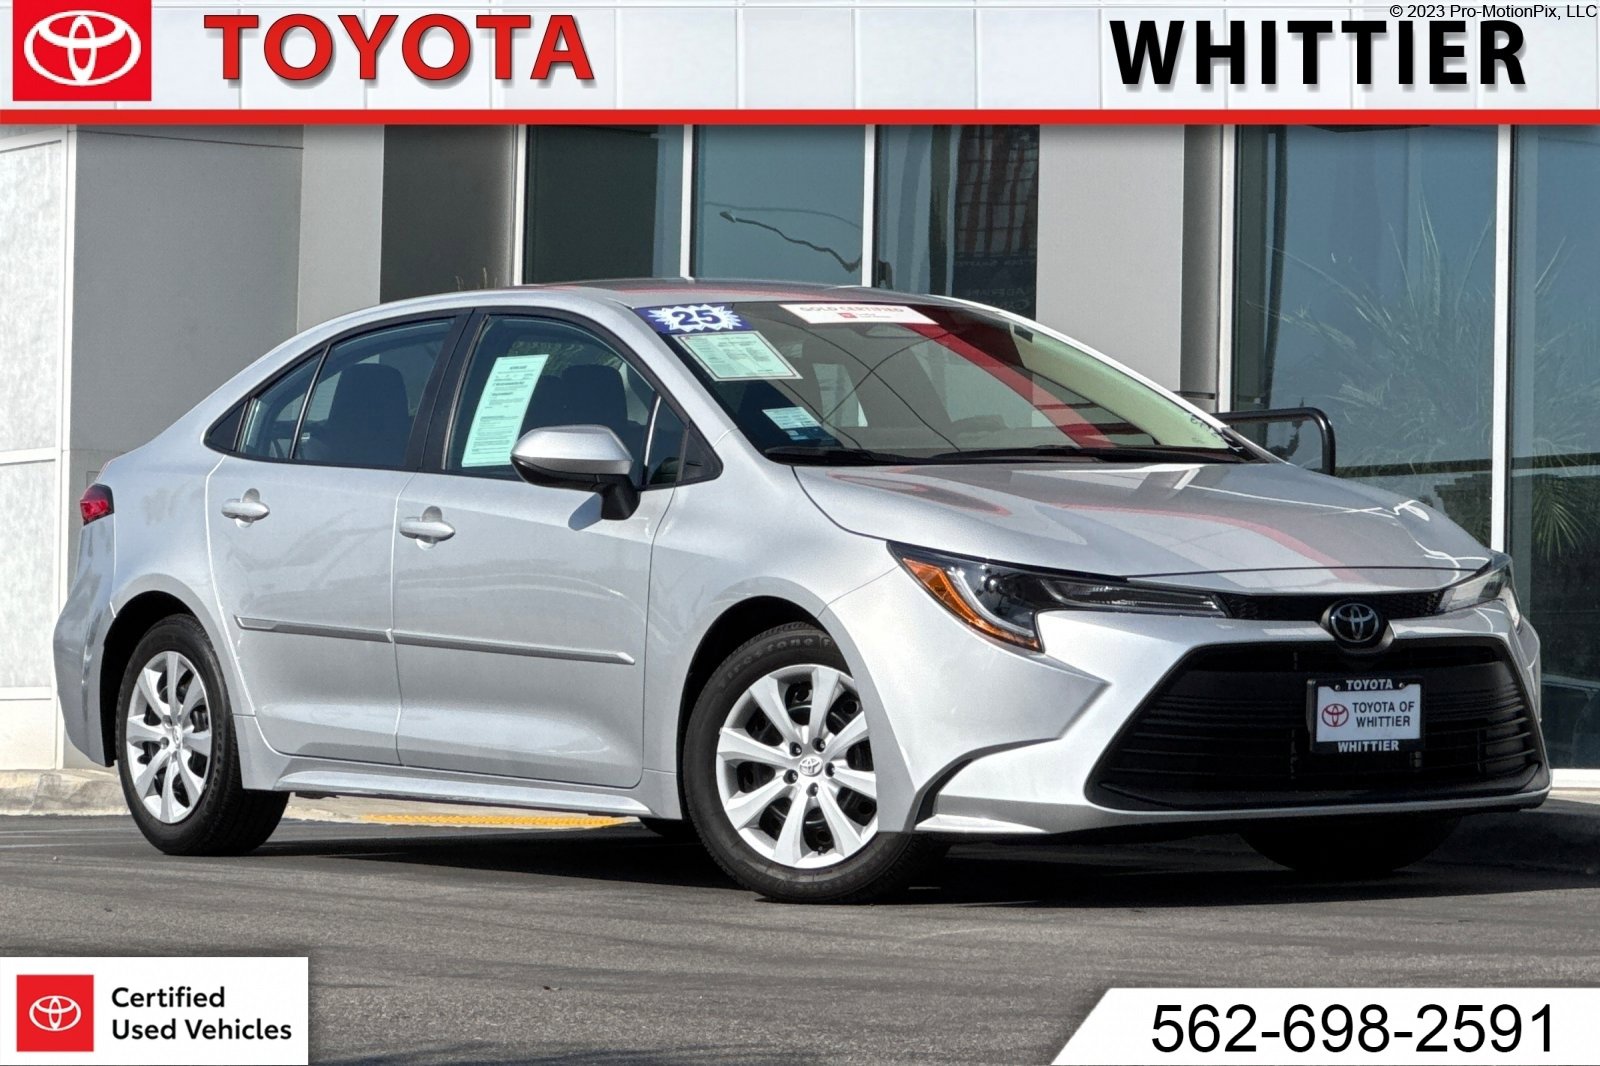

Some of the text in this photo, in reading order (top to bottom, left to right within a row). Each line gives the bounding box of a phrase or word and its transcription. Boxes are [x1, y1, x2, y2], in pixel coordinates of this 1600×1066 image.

[671, 308, 723, 326] 25
[1346, 679, 1393, 690] TOYOTA
[1352, 701, 1415, 713] TOYOTA OF
[1356, 715, 1411, 728] WHITTIER
[1337, 740, 1400, 753] WHITTIER
